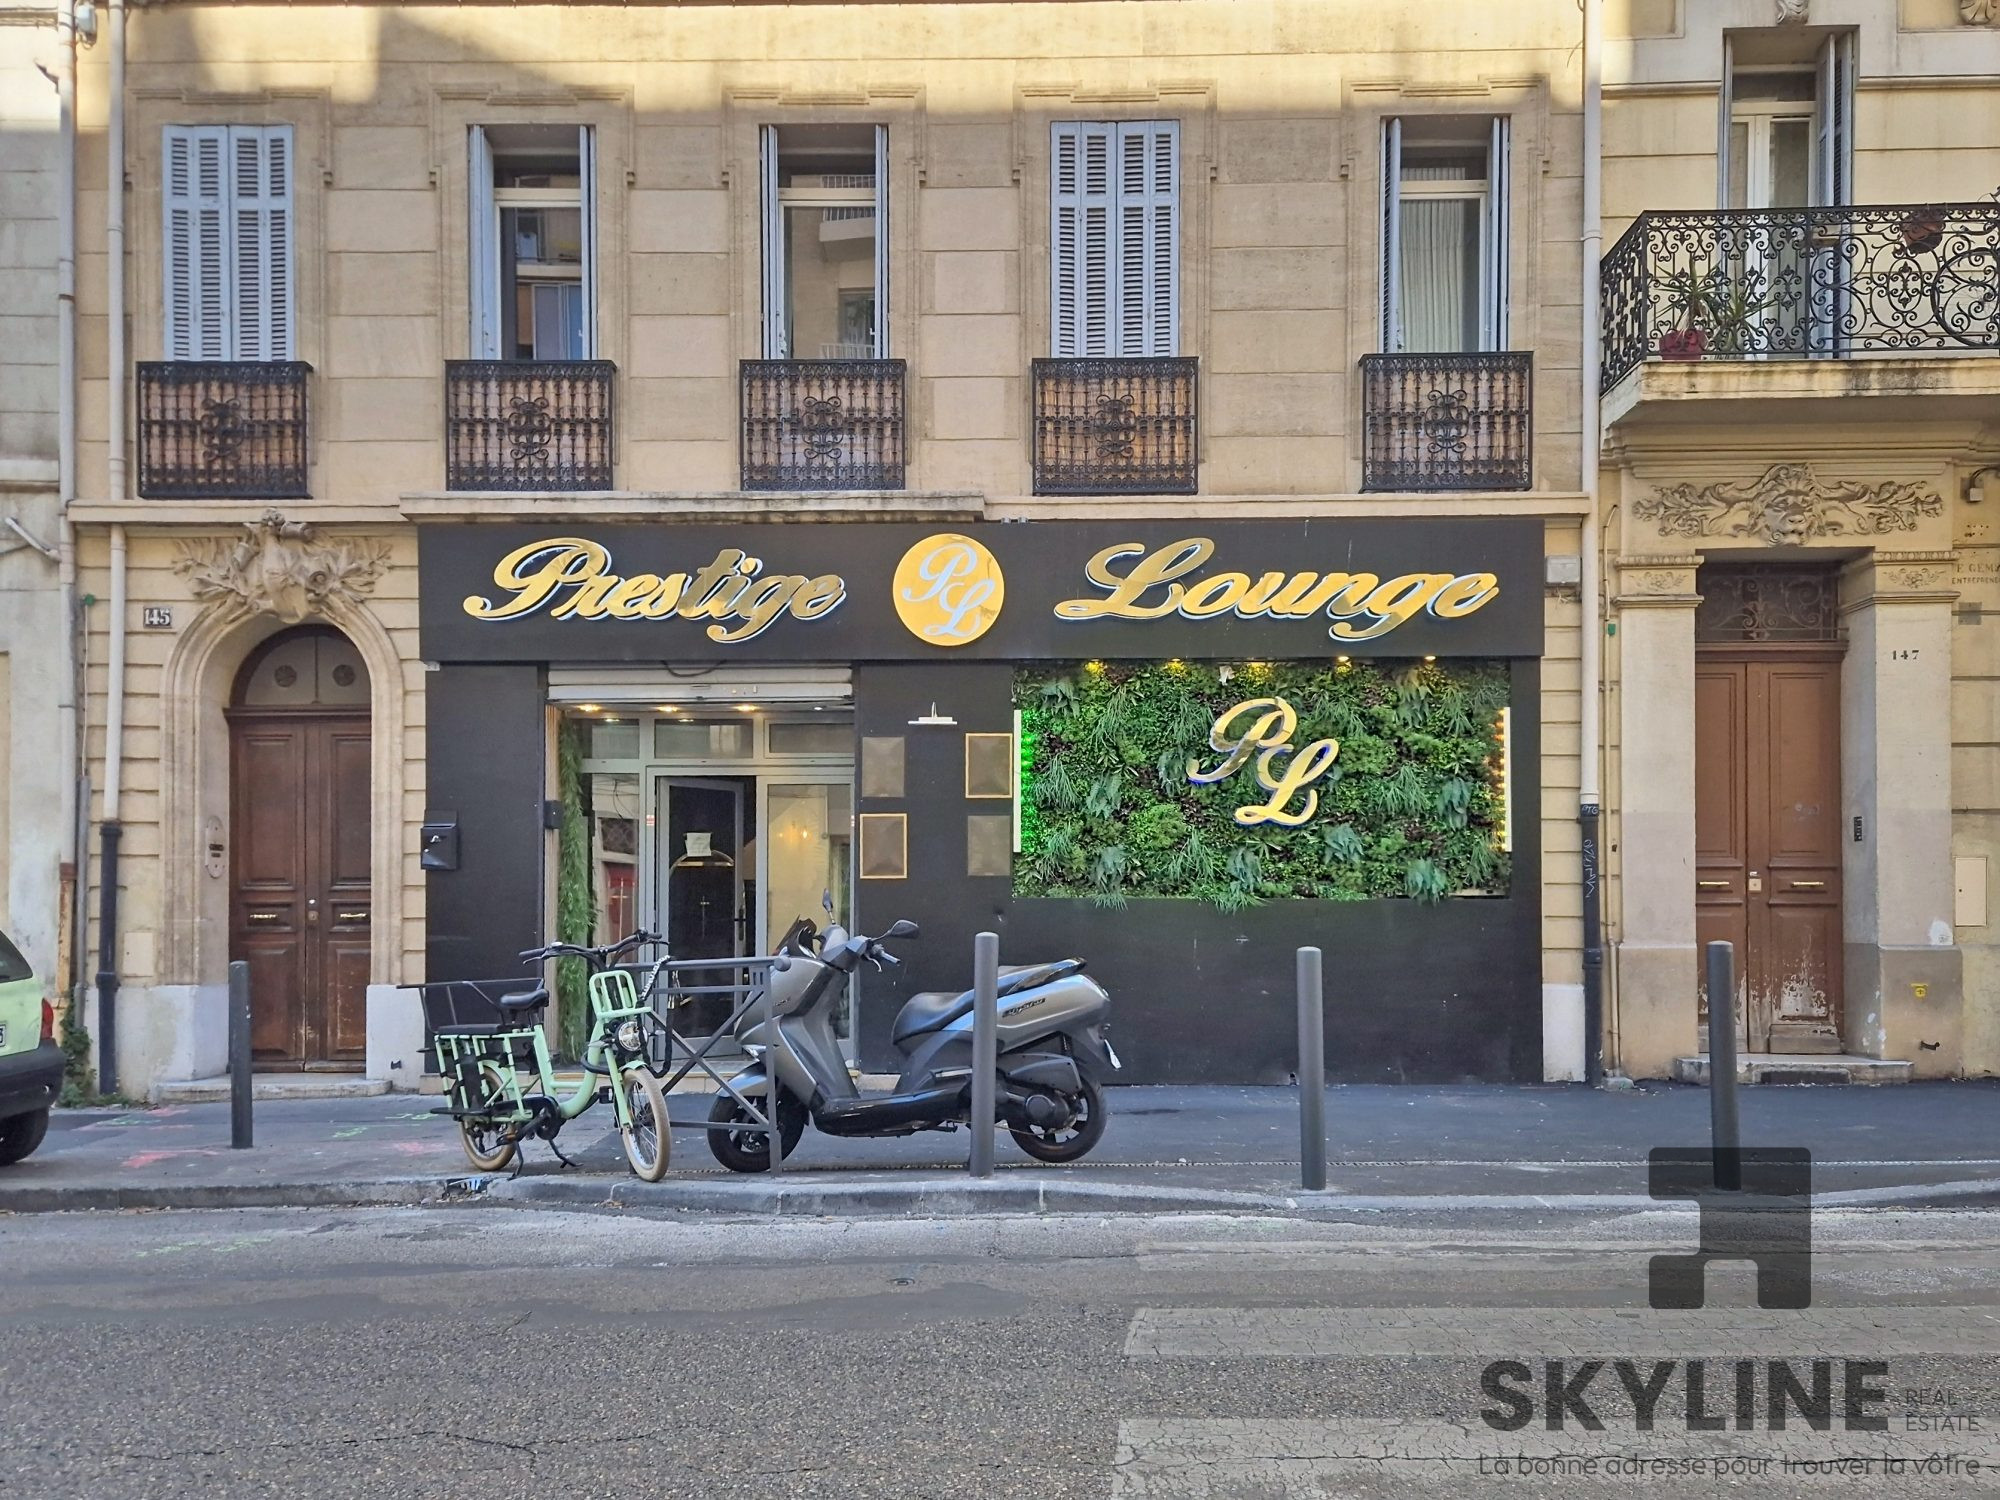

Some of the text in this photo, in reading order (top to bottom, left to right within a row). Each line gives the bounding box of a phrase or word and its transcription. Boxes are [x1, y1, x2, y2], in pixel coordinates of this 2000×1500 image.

[145, 608, 171, 625] 145
[463, 537, 846, 643] Prestige
[1053, 537, 1500, 642] Lounge
[1892, 649, 1920, 661] 147
